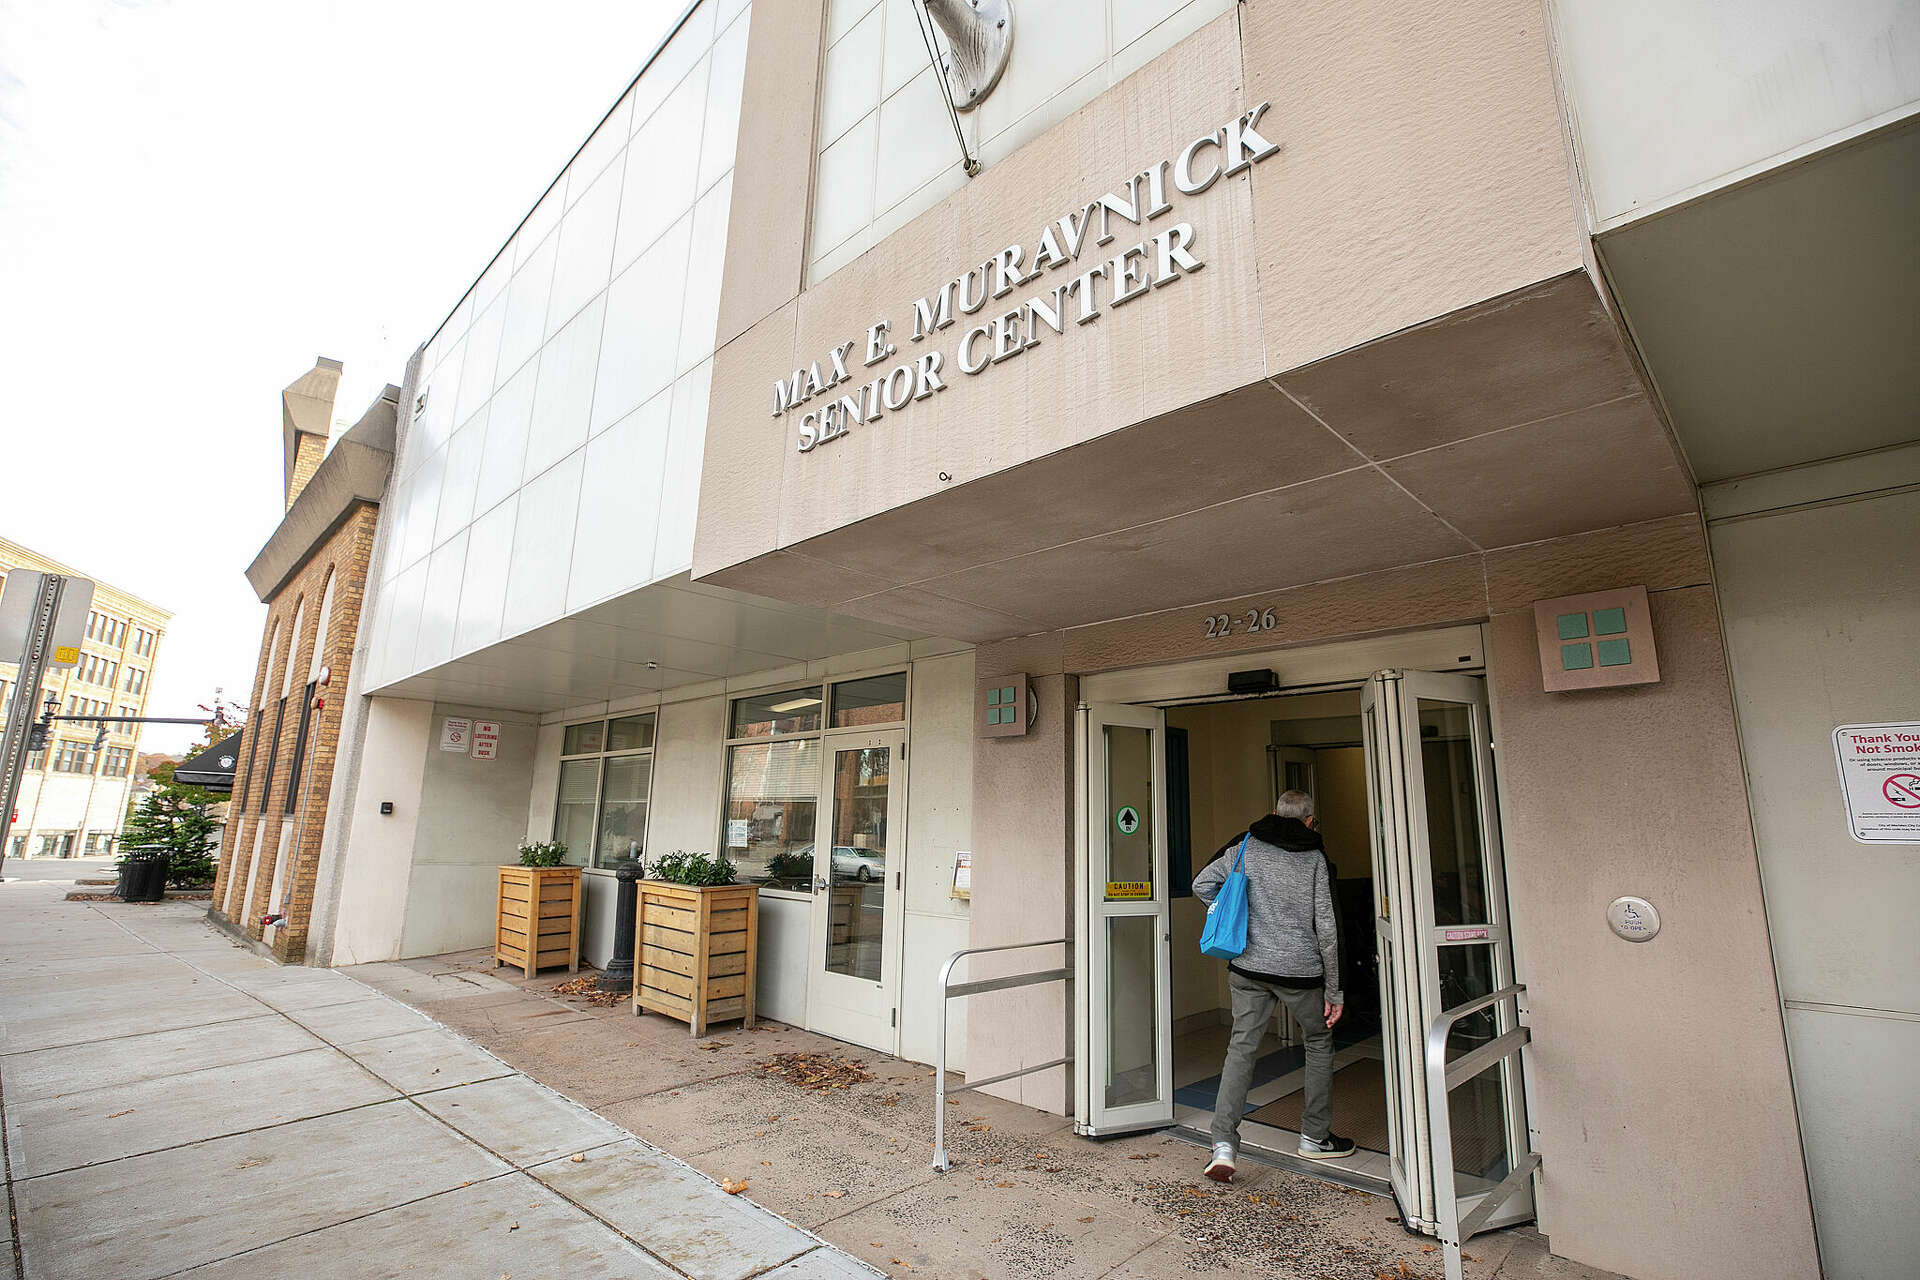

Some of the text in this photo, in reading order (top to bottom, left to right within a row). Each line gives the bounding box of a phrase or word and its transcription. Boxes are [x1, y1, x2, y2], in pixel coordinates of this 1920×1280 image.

[772, 101, 1282, 418] MAX E. MURAVNICK
[797, 222, 1206, 454] SENIOR CENTER
[1850, 733, 1920, 744] Thank You
[1855, 745, 1880, 754] Not
